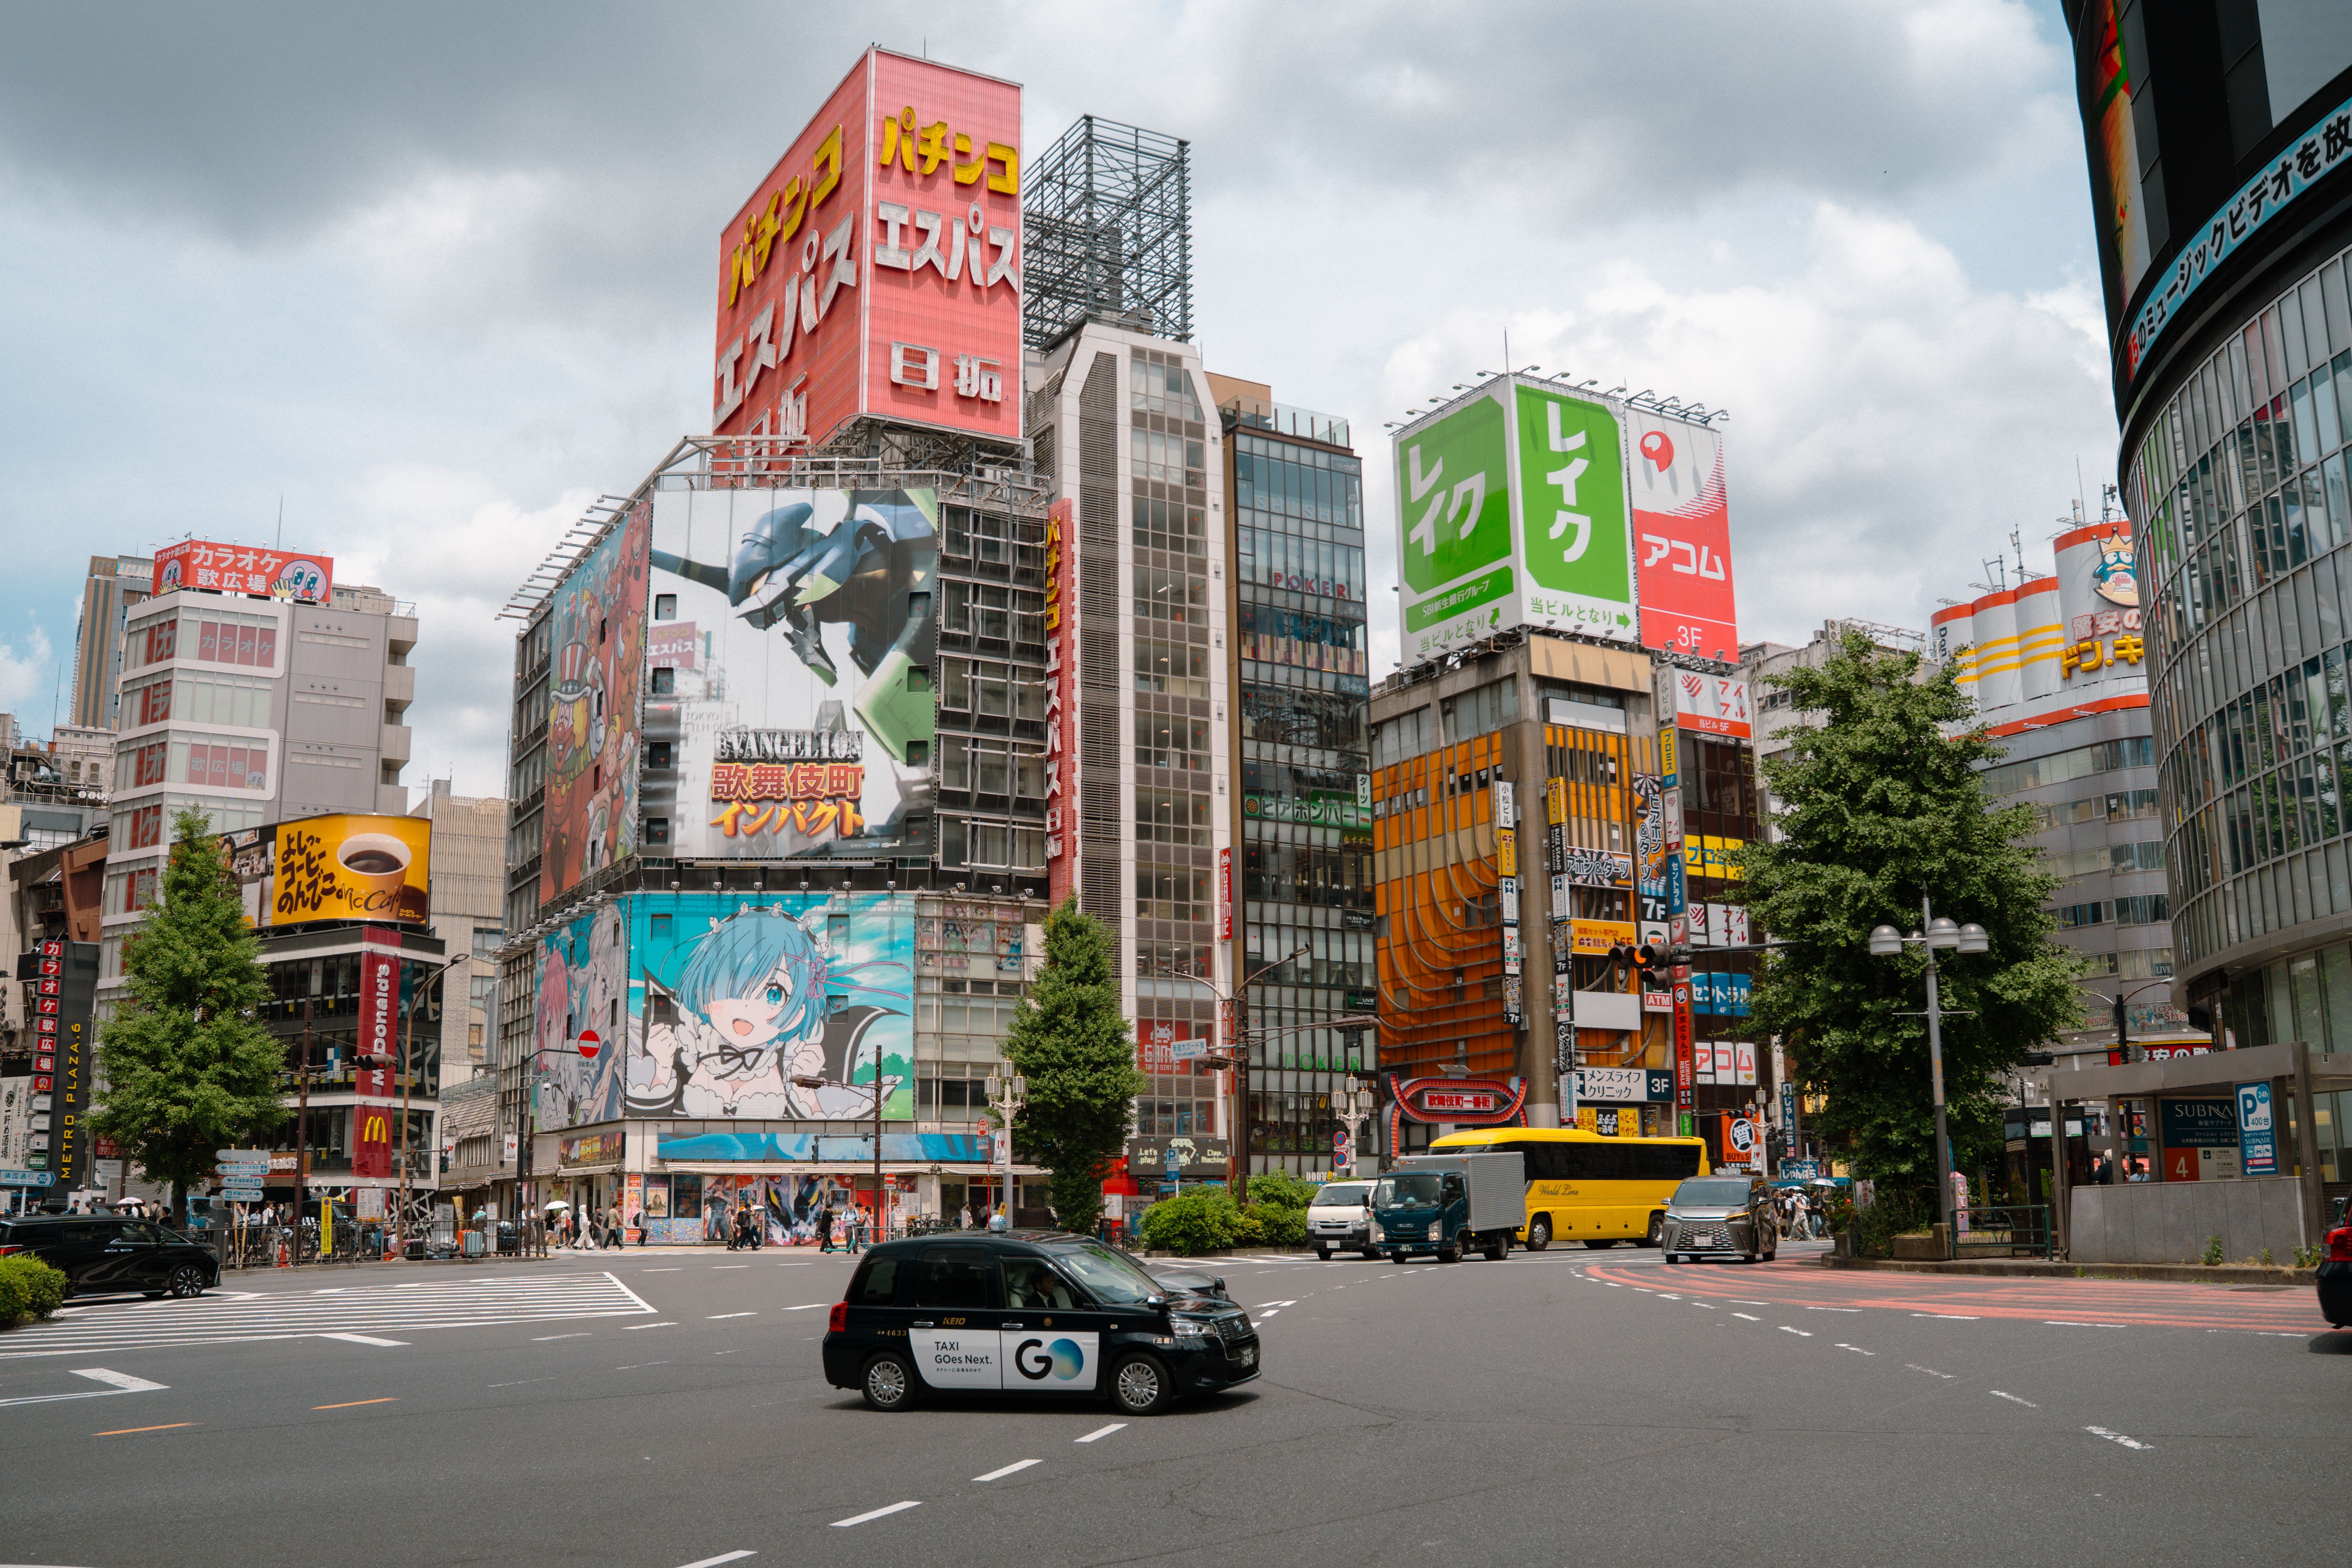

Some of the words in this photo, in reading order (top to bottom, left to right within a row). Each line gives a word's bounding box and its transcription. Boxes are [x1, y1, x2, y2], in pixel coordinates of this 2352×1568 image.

[879, 106, 1018, 195] パチンコ
[727, 124, 843, 309] パチンコ
[875, 200, 1019, 294] エスパス
[713, 210, 857, 430] エスパス
[1547, 400, 1591, 563] レイク
[1257, 495, 1344, 525] SHISHA
[1409, 443, 1485, 557] レイク
[156, 543, 191, 563] カラオケ歌広場
[191, 544, 282, 574] カラオケ
[1642, 533, 1726, 582] アコム
[197, 568, 268, 592] 歌広場
[1046, 515, 1061, 631] パチンコ
[1274, 572, 1346, 598] POKER
[1422, 579, 1491, 619] SBI新生銀行グループ
[1530, 597, 1613, 627] 当ビルとなり
[1420, 607, 1486, 653] 当ビルとなり
[1677, 625, 1702, 647] 3F
[2072, 608, 2142, 640] 驚安の
[201, 633, 274, 656] カラオケ
[648, 639, 694, 656] エスパス
[1660, 672, 1669, 715] 戸谷ビル
[1045, 637, 1061, 799] エスパス
[1699, 719, 1718, 729] 当ビル
[1720, 722, 1729, 731] 5F
[714, 730, 864, 763] EVANGELION
[1664, 732, 1673, 771] プロミス
[191, 756, 246, 776] 歌広場
[711, 763, 865, 802] 歌舞伎町
[1359, 776, 1368, 804] ダーツ
[1262, 799, 1355, 823] ビアポンバー
[1501, 784, 1511, 824] 小松ビル
[709, 800, 865, 838] インパクト
[1649, 794, 1663, 854] ビアポン
[1639, 822, 1652, 883] &ダーツ
[281, 850, 326, 890] コーヒー
[277, 869, 336, 915] のんでこ
[1671, 862, 1680, 907] セントラル
[1223, 866, 1231, 935] GAME
[1642, 898, 1666, 920] 7F
[1556, 961, 1566, 971] 7F
[2155, 965, 2171, 974] LIVE
[40, 942, 59, 1069] カラオケ歌広場
[1647, 995, 1670, 1005] ATM
[1693, 983, 1748, 1004] セントラル
[372, 964, 390, 1086] MDonald's
[1508, 1013, 1520, 1023] 7F
[1172, 1041, 1205, 1052] 新宿大ガード東
[1695, 1048, 1753, 1071] アコム
[66, 1023, 81, 1102] PLAZA.6
[1285, 1054, 1361, 1072] POKER
[1587, 1070, 1641, 1083] メンズライフ
[1651, 1078, 1669, 1093] 3F
[1427, 1095, 1490, 1108] 歌舞伎町一番街
[1588, 1085, 1631, 1098] クリニック
[1624, 1112, 1637, 1124] ビール
[2242, 1093, 2257, 1127] P
[1625, 1127, 1638, 1137] サワー
[1733, 1122, 1752, 1149] 質
[61, 1115, 74, 1178] METRO
[1139, 1148, 1158, 1156] Let's
[1168, 1150, 1176, 1162] P
[1782, 1169, 1816, 1180] じゃんぱら
[2176, 1157, 2189, 1178] 4
[1539, 1184, 1559, 1196] World
[1561, 1183, 1579, 1196] Line
[942, 1317, 966, 1326] KEIO
[934, 1342, 959, 1351] TAXI
[935, 1355, 963, 1364] GOes
[965, 1355, 992, 1364] Next.
